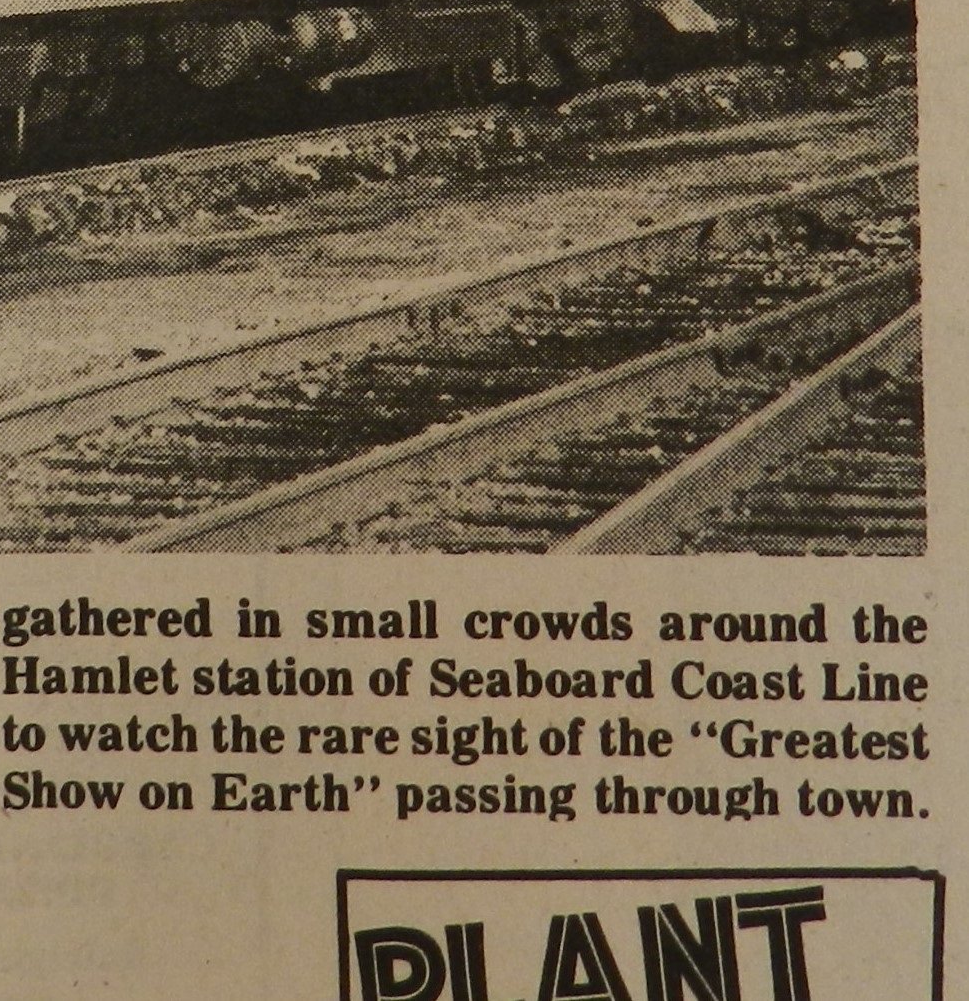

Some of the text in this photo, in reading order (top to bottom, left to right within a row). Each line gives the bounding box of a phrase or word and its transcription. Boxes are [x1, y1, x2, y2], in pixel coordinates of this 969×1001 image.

[2, 596, 928, 648] gathered in small crowds around the
[2, 655, 929, 703] Hamlet station of Seaboard Coast Line
[2, 713, 930, 767] to watch the rare sight of the “Greatest
[2, 769, 930, 823] Show on Earth” passing through town.
[354, 886, 826, 1001] PLANT
